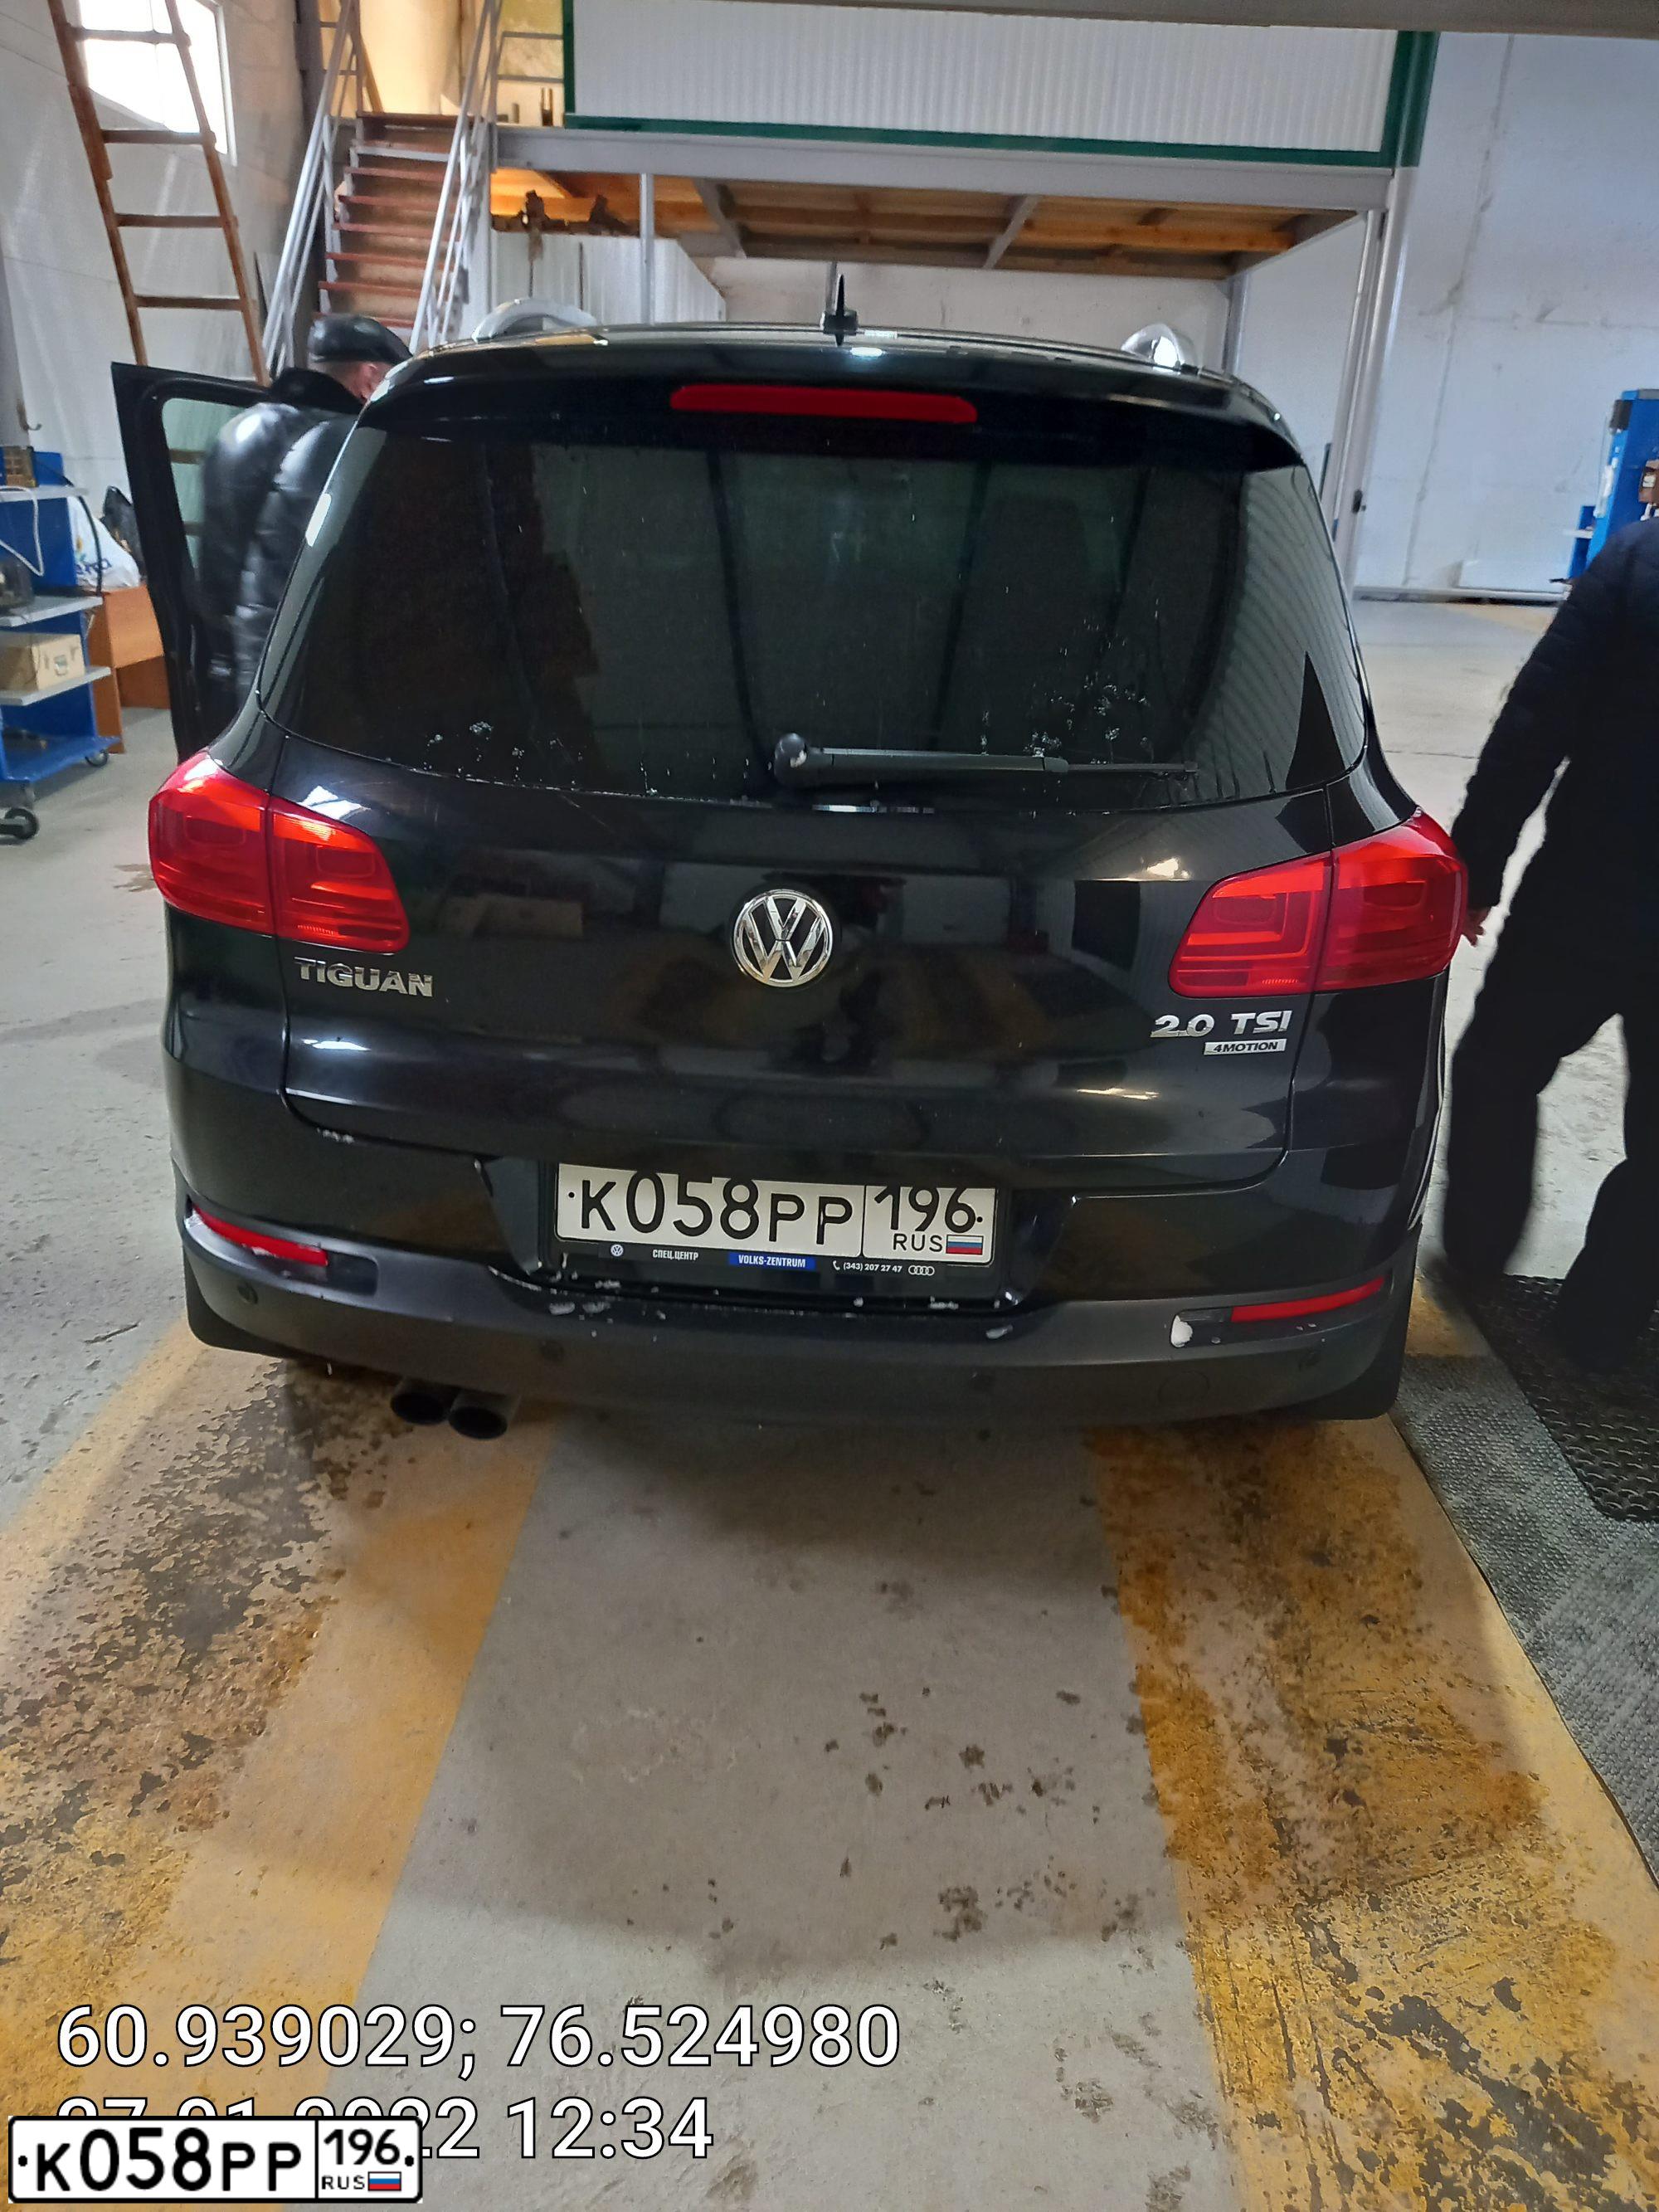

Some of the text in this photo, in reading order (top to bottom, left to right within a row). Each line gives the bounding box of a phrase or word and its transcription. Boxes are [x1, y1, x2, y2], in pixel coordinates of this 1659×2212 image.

[294, 957, 433, 997] TIGUAN
[1151, 1011, 1293, 1037] 2.0 TSI
[1213, 1041, 1279, 1053] 4MOTION
[874, 1186, 976, 1233] 196
[893, 1233, 943, 1253] RUS
[652, 1249, 699, 1261] СПЕЦ.ЦЕНТР
[737, 1255, 806, 1268] VOLKS-ZENTRUM
[843, 1262, 864, 1271] (343)
[864, 1263, 880, 1271] 207
